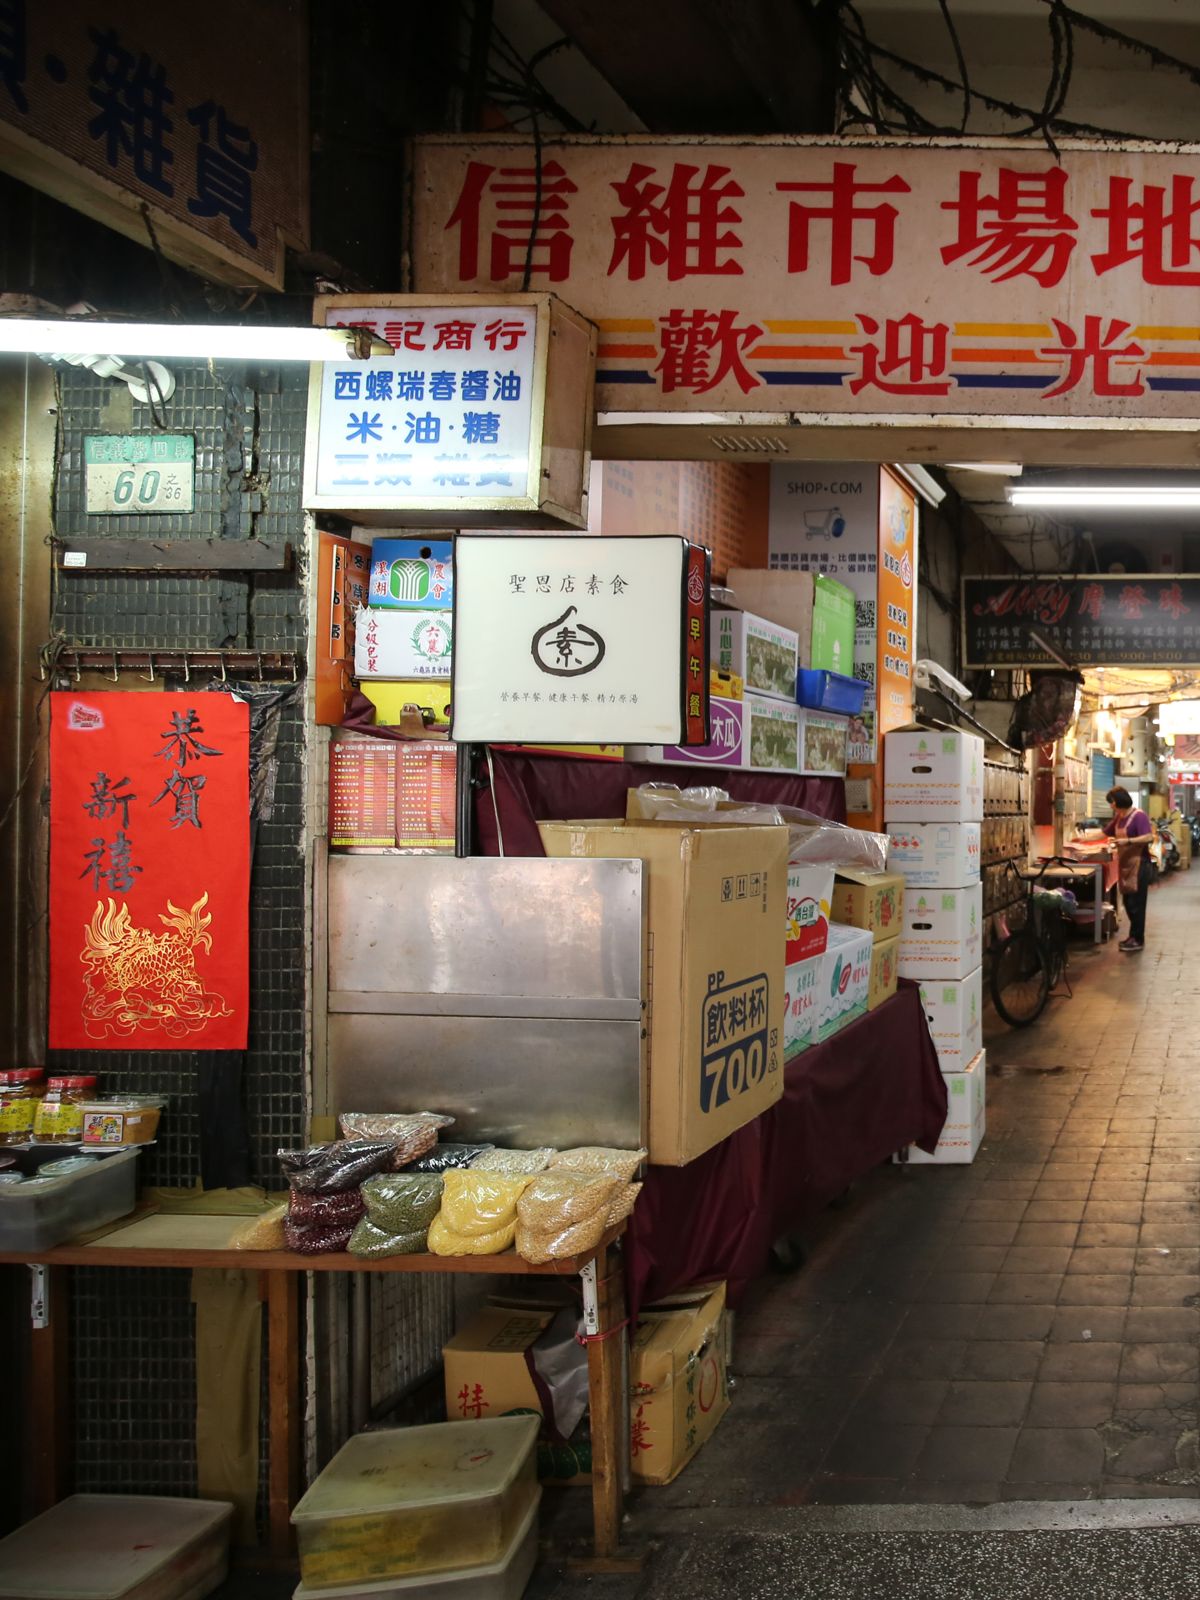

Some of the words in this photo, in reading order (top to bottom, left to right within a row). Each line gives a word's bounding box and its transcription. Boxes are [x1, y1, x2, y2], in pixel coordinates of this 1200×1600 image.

[334, 370, 522, 401] 西螺瑞春醬油
[113, 470, 161, 505] 60
[165, 487, 182, 500] 36
[431, 562, 448, 600] 農會
[509, 574, 630, 596] 聖恩店素食
[545, 627, 595, 668] 素
[689, 617, 702, 718] 早午餐
[712, 716, 735, 748] 木瓜
[149, 708, 224, 830] 恭賀
[79, 771, 144, 894] 新禧
[707, 970, 725, 989] PP
[706, 986, 765, 1048] 飲料杯
[705, 1040, 765, 1112] 700
